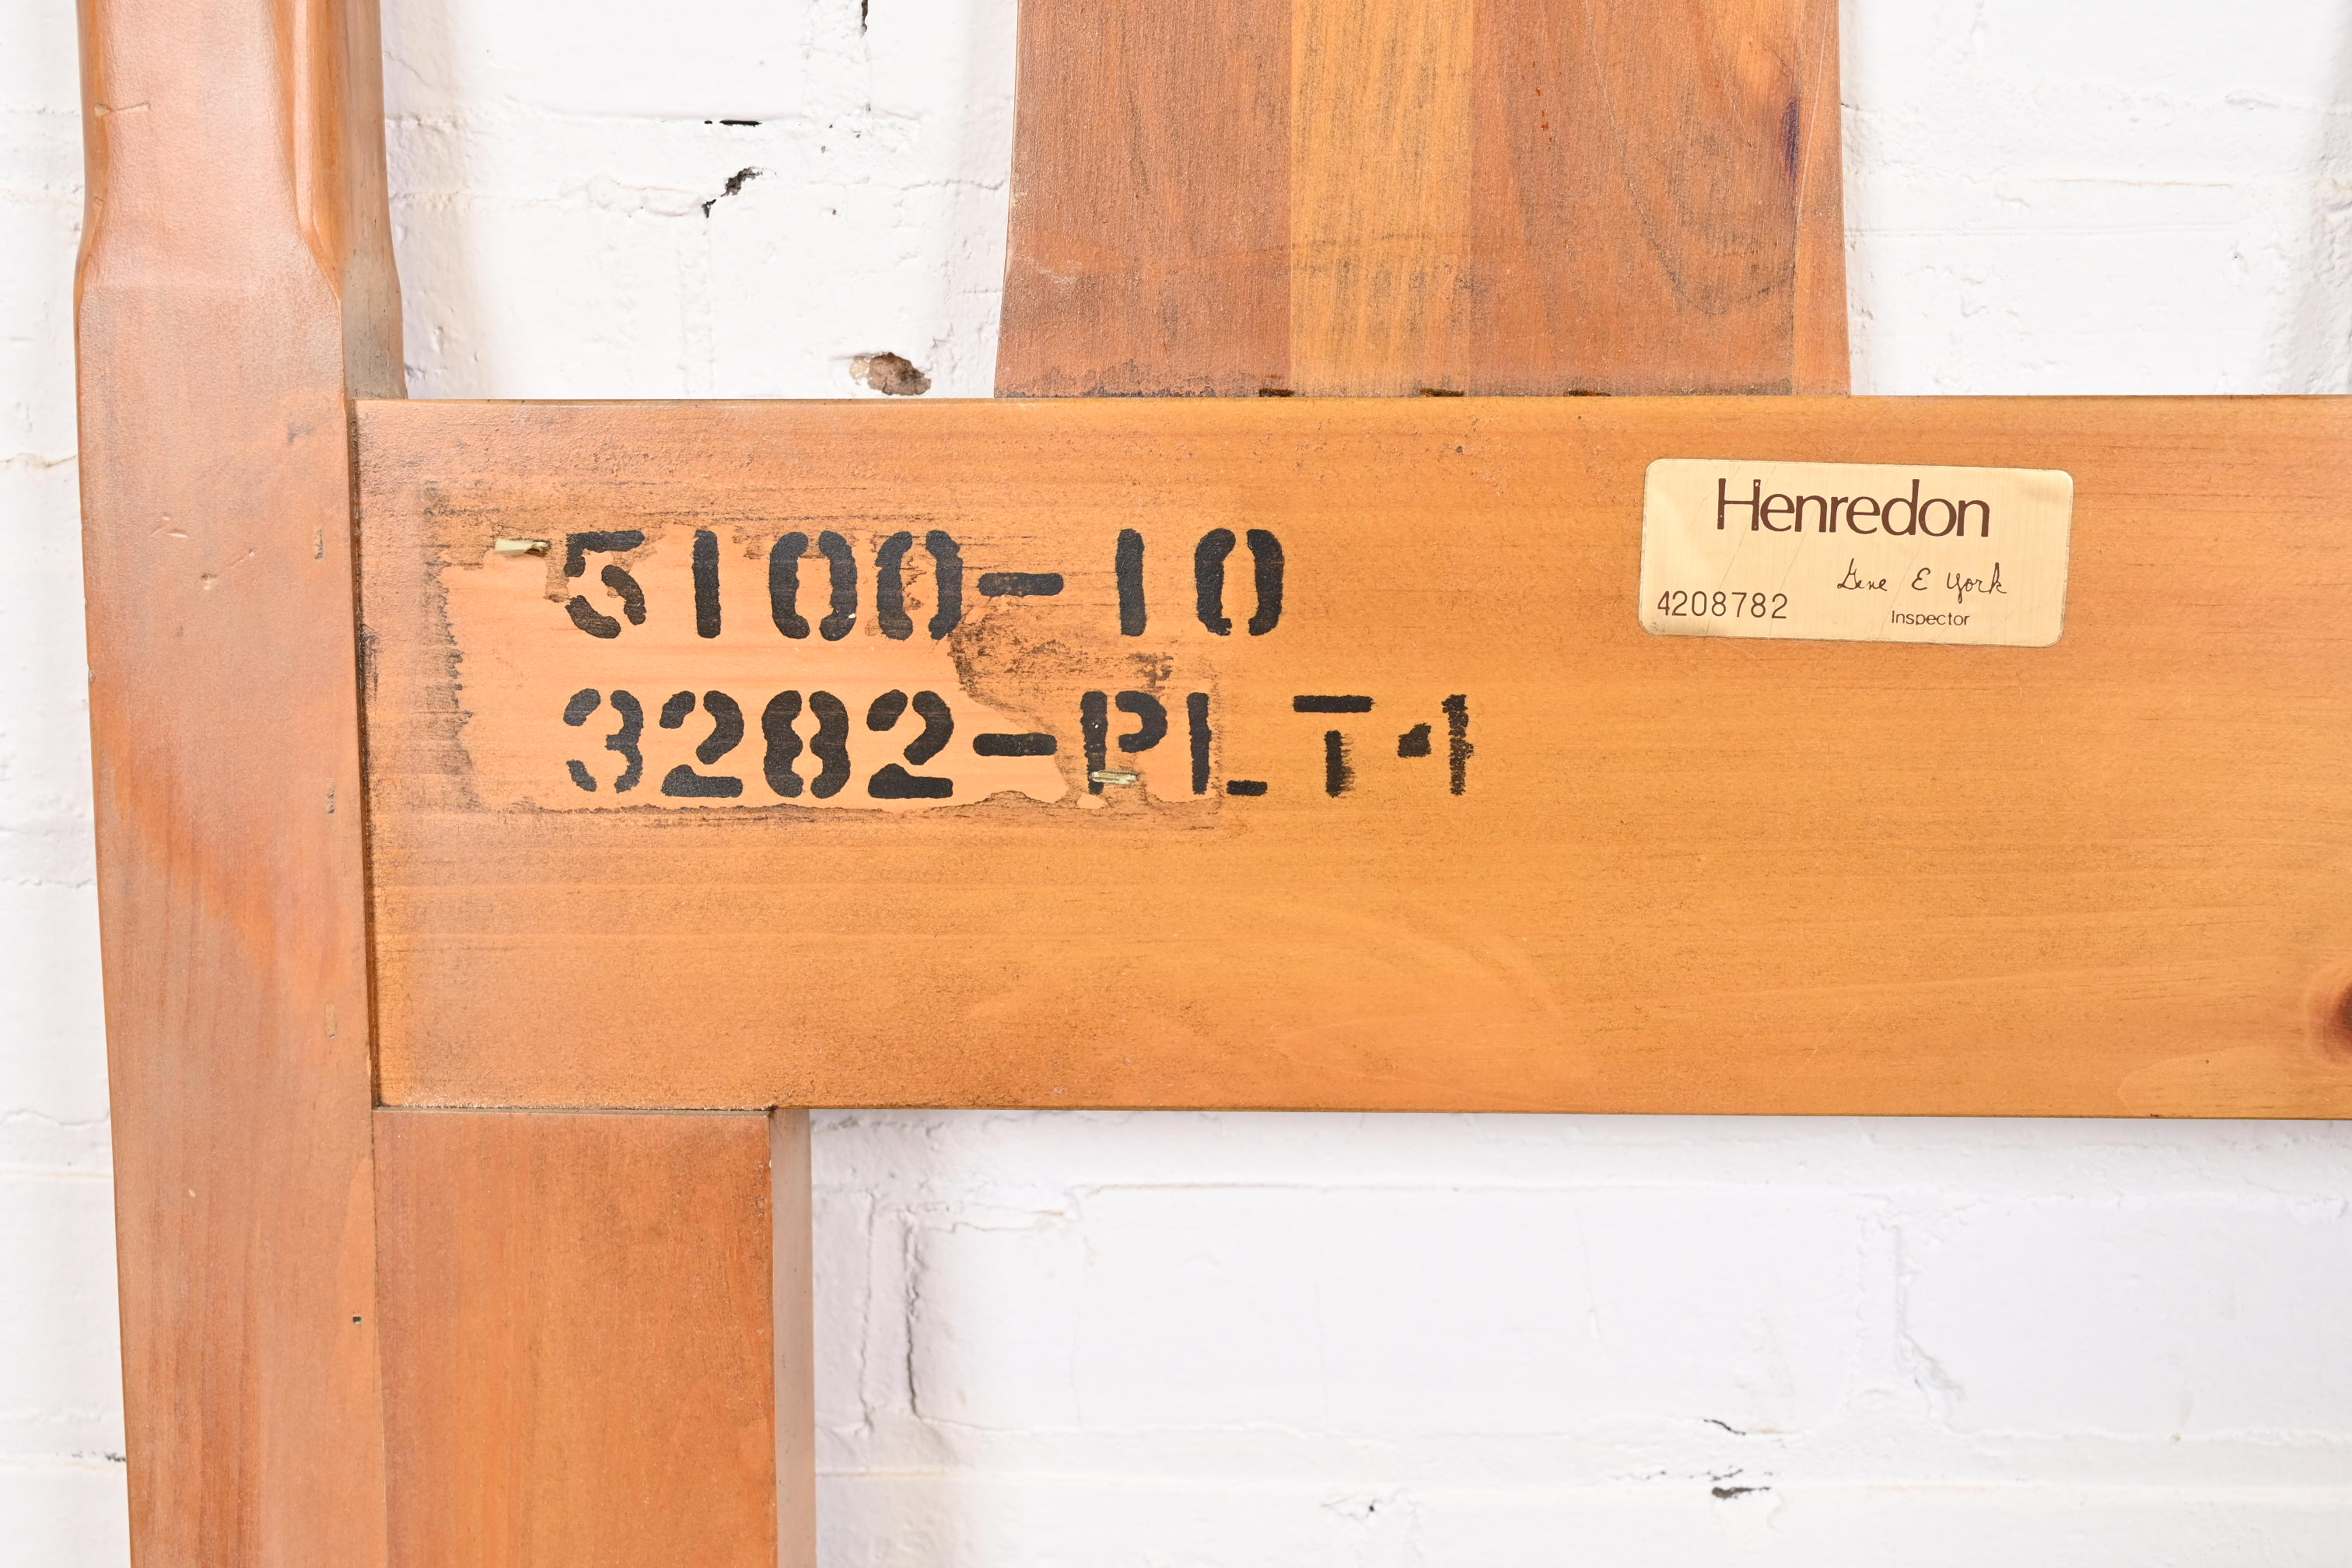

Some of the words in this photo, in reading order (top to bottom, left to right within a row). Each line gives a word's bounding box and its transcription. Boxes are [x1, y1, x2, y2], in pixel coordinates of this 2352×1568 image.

[1717, 478, 1991, 538] Henredon
[563, 529, 1286, 642] 5100-10
[1911, 567, 1931, 591] E
[1657, 590, 1788, 619] 4208782
[1891, 610, 1970, 626] Inspector
